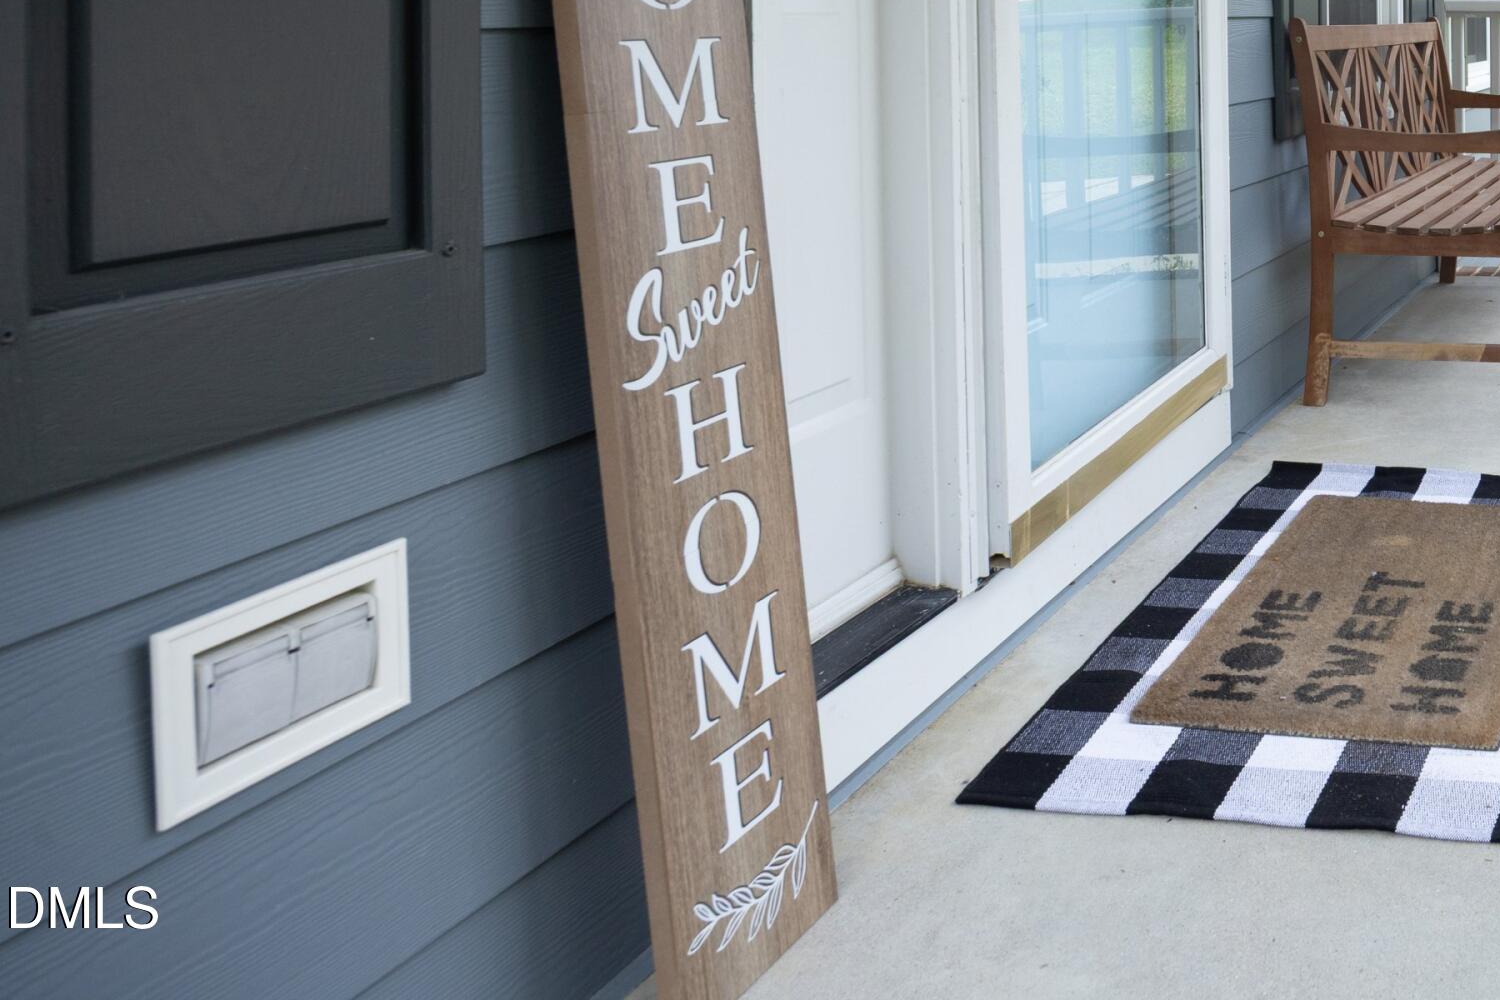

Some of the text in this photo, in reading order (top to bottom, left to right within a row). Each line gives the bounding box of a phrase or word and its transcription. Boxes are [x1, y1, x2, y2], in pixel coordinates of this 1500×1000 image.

[622, 226, 760, 391] Sweet
[664, 363, 787, 855] HOME
[1188, 588, 1322, 702] HOME
[1293, 570, 1427, 709] SWEET
[1390, 600, 1495, 716] HOME
